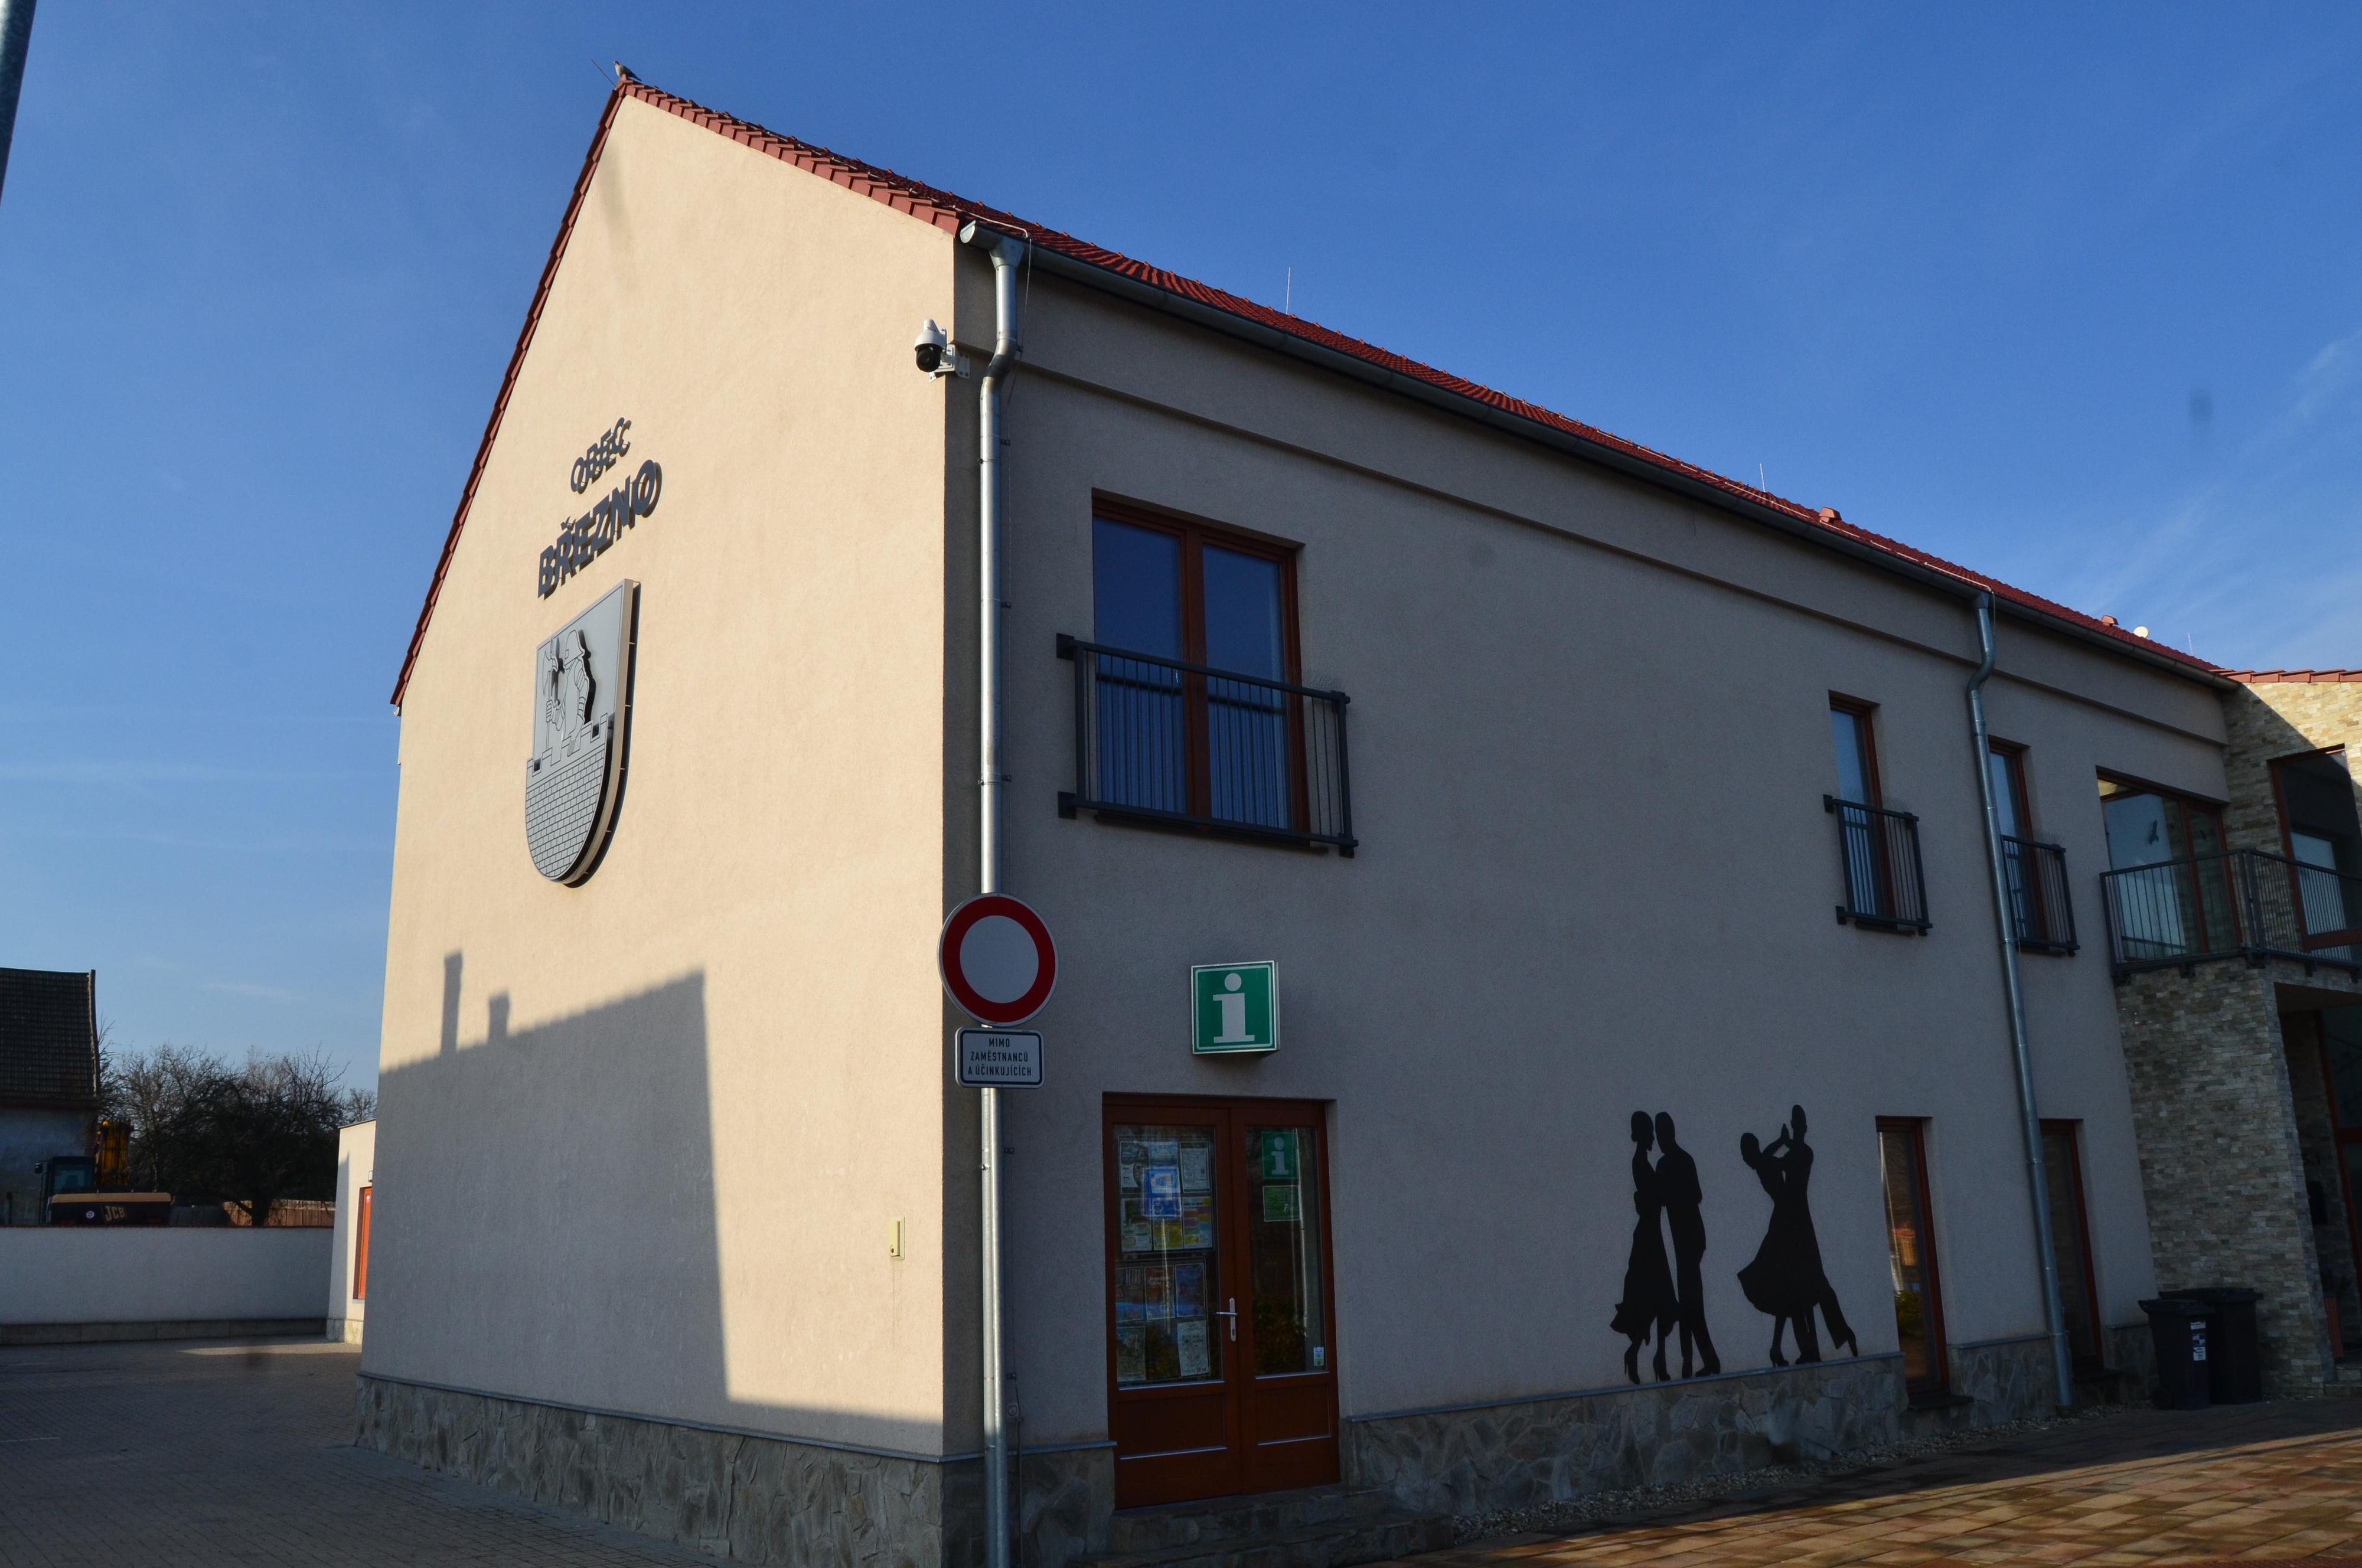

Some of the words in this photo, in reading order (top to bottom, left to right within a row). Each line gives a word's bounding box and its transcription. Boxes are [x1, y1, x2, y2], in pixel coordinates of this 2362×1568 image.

[570, 417, 627, 492] OBEC
[537, 459, 657, 599] BŘEZNO
[988, 1038, 1010, 1047] MIMO
[970, 1051, 1028, 1062] ZAMĚSTNANCŮ
[968, 1066, 973, 1075] A
[976, 1064, 1032, 1076] ÚČINKUJÍCÍCH
[105, 1206, 125, 1221] JCB
